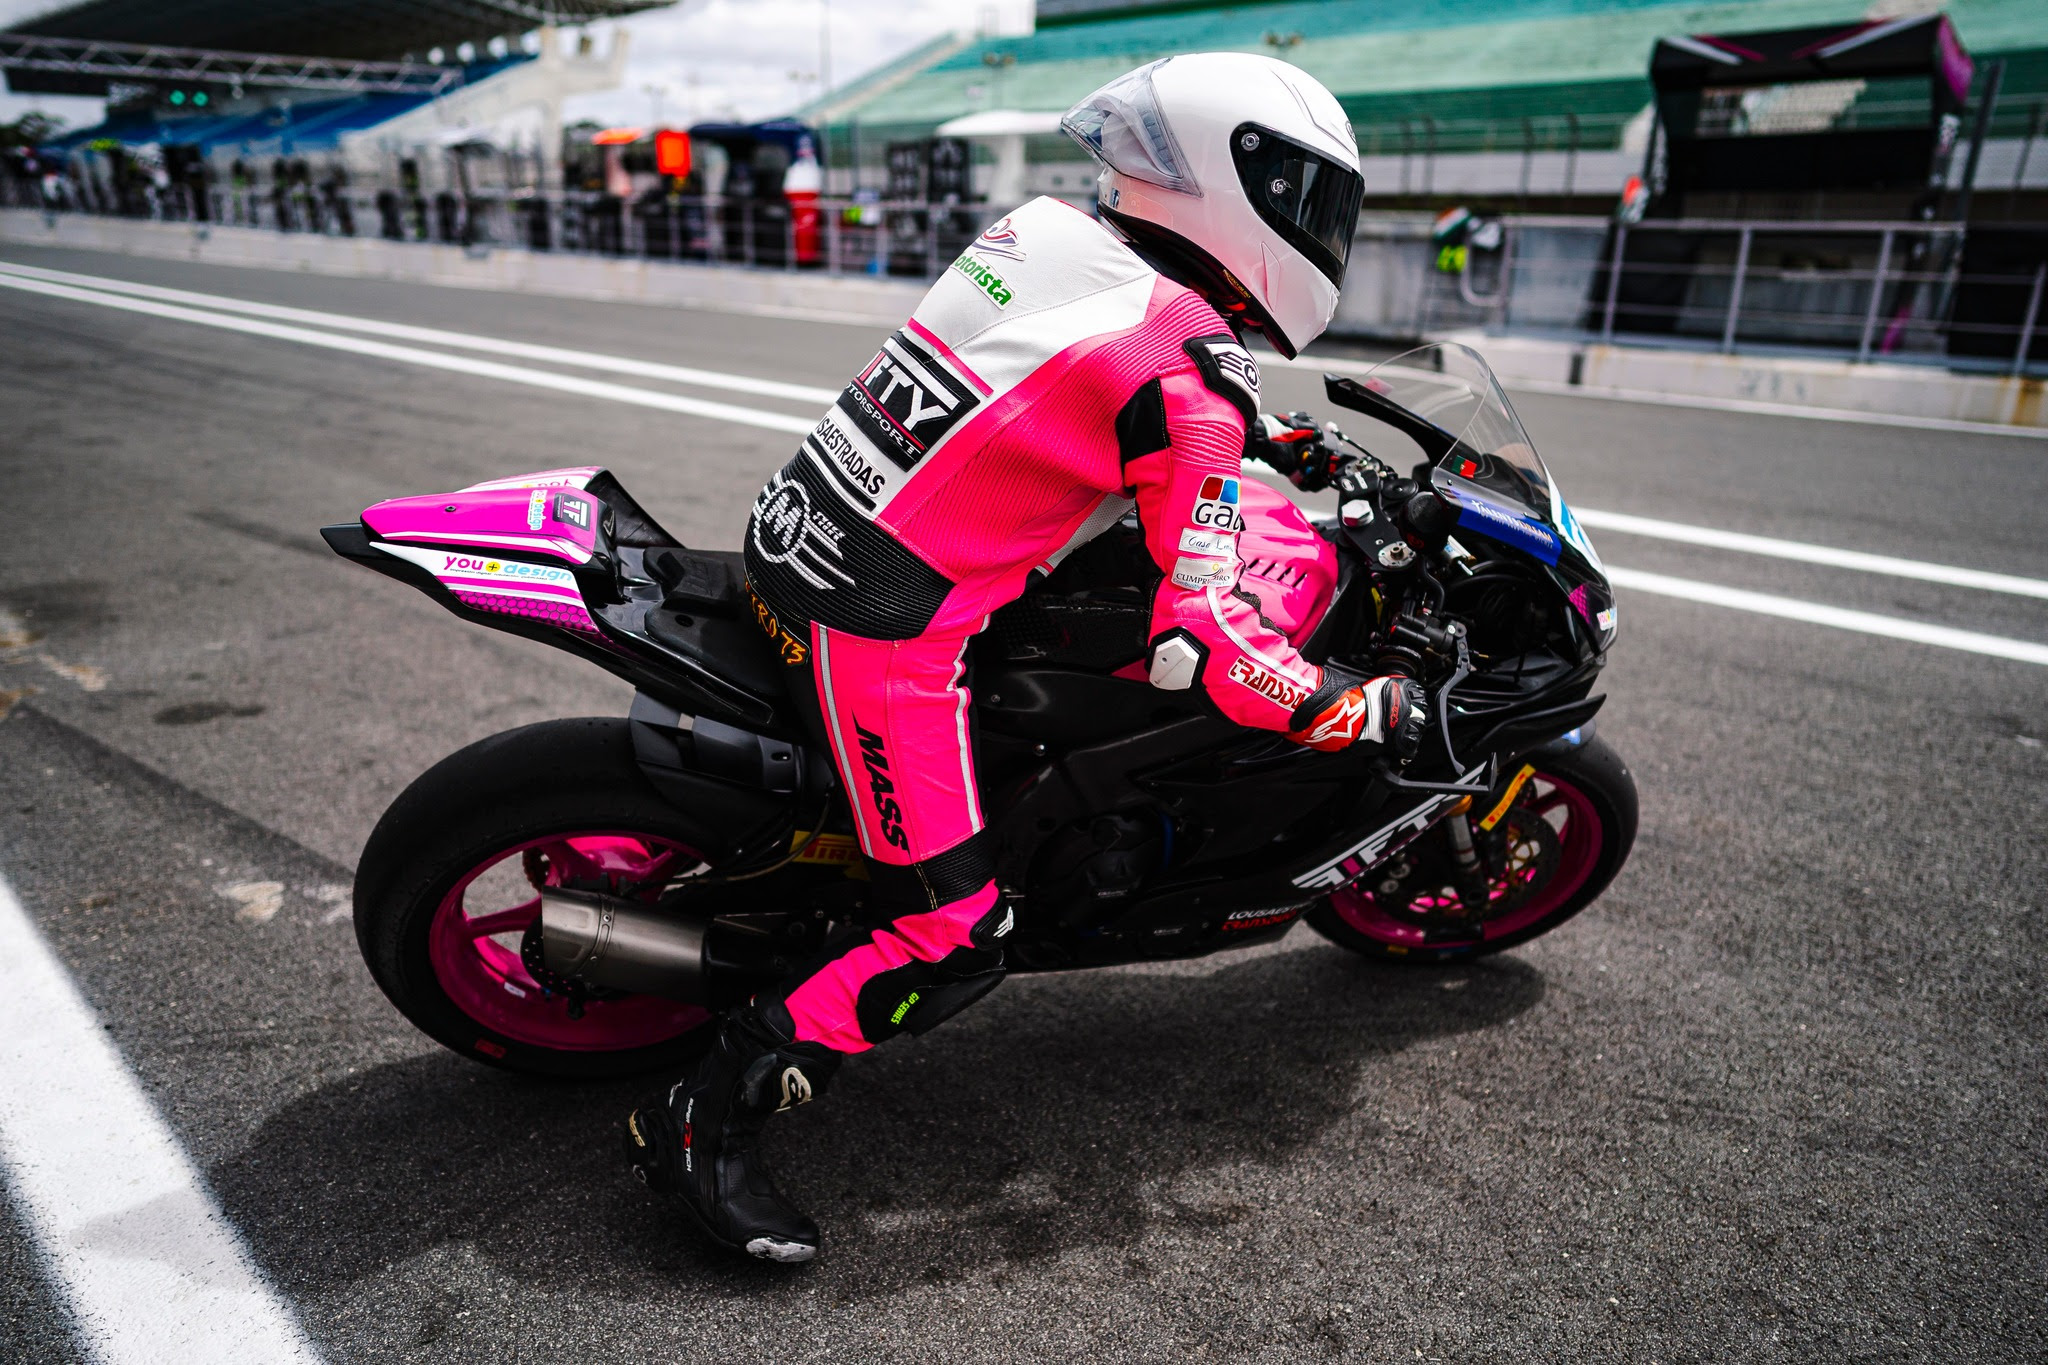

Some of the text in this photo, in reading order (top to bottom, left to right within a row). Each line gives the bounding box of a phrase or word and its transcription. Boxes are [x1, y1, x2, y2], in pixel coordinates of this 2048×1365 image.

[857, 350, 949, 432] IFTY
[443, 556, 484, 570] you
[503, 564, 573, 581] design
[781, 631, 806, 664] 73
[851, 706, 912, 860] MASS
[891, 992, 919, 1024] GP SERIES
